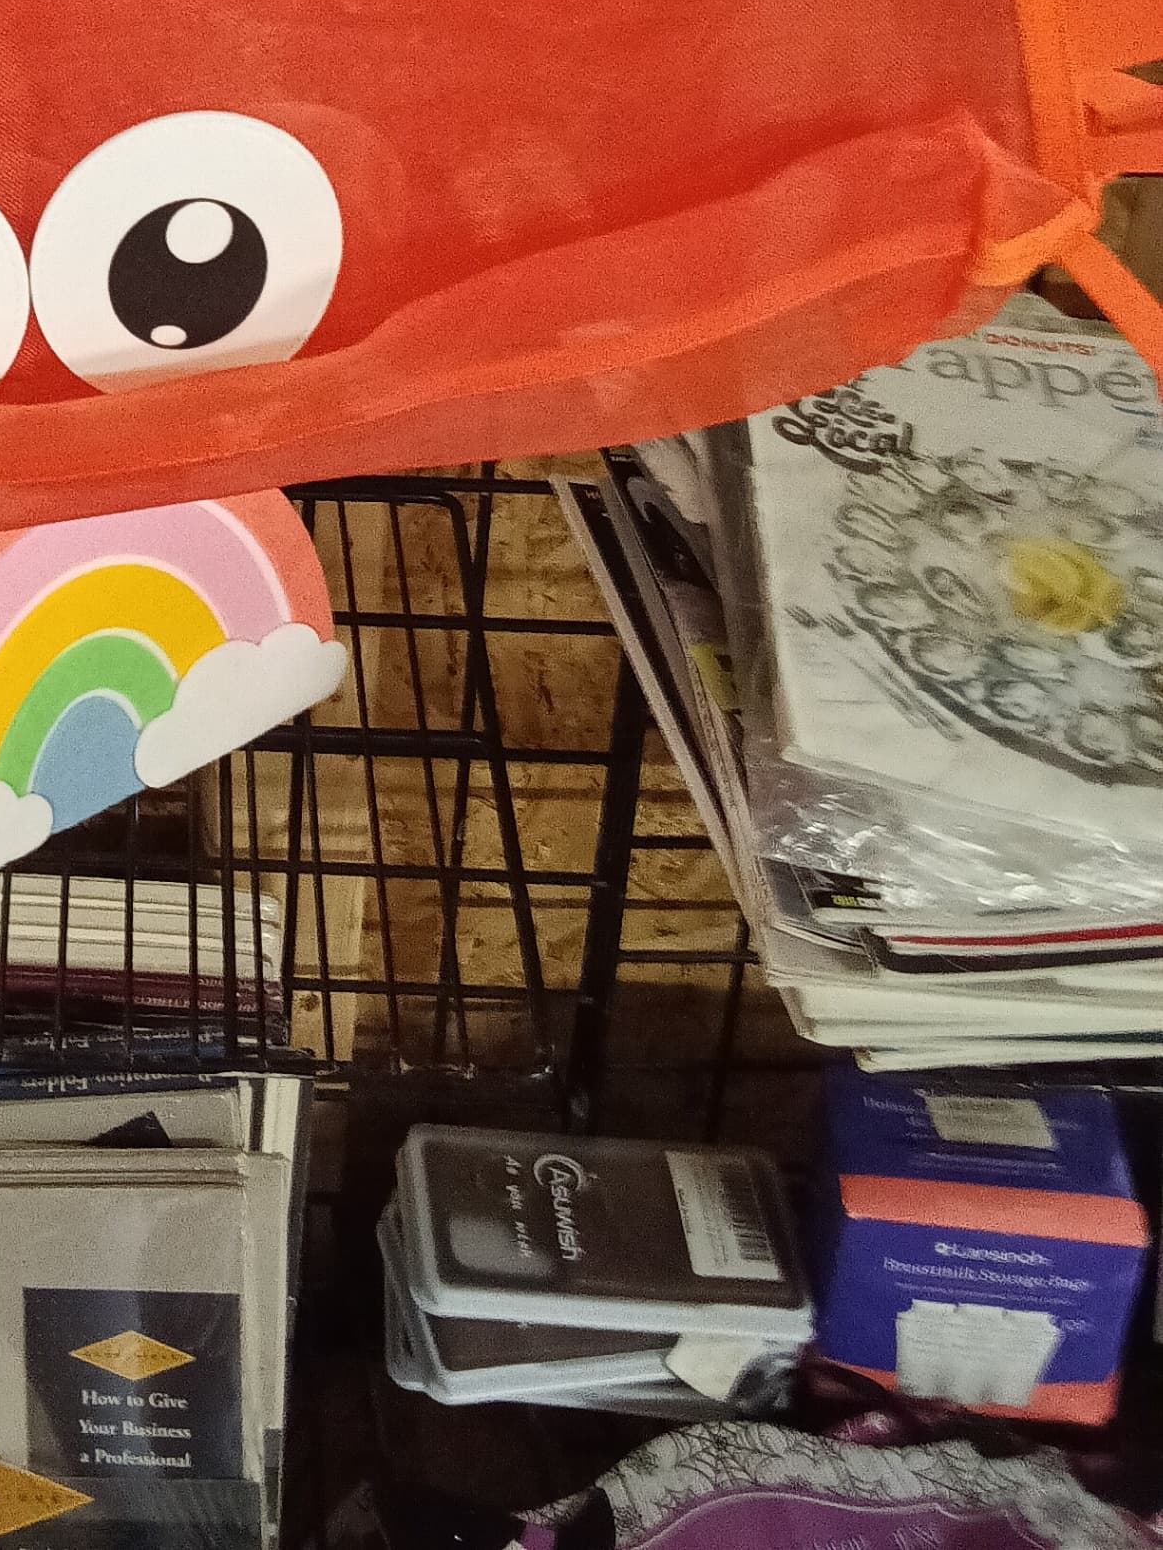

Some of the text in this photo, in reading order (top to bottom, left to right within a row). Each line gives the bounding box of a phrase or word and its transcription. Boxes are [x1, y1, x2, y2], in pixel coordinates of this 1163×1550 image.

[81, 1389, 190, 1410] How to Give
[79, 1418, 192, 1440] Your Business
[79, 1447, 192, 1468] a Professional
